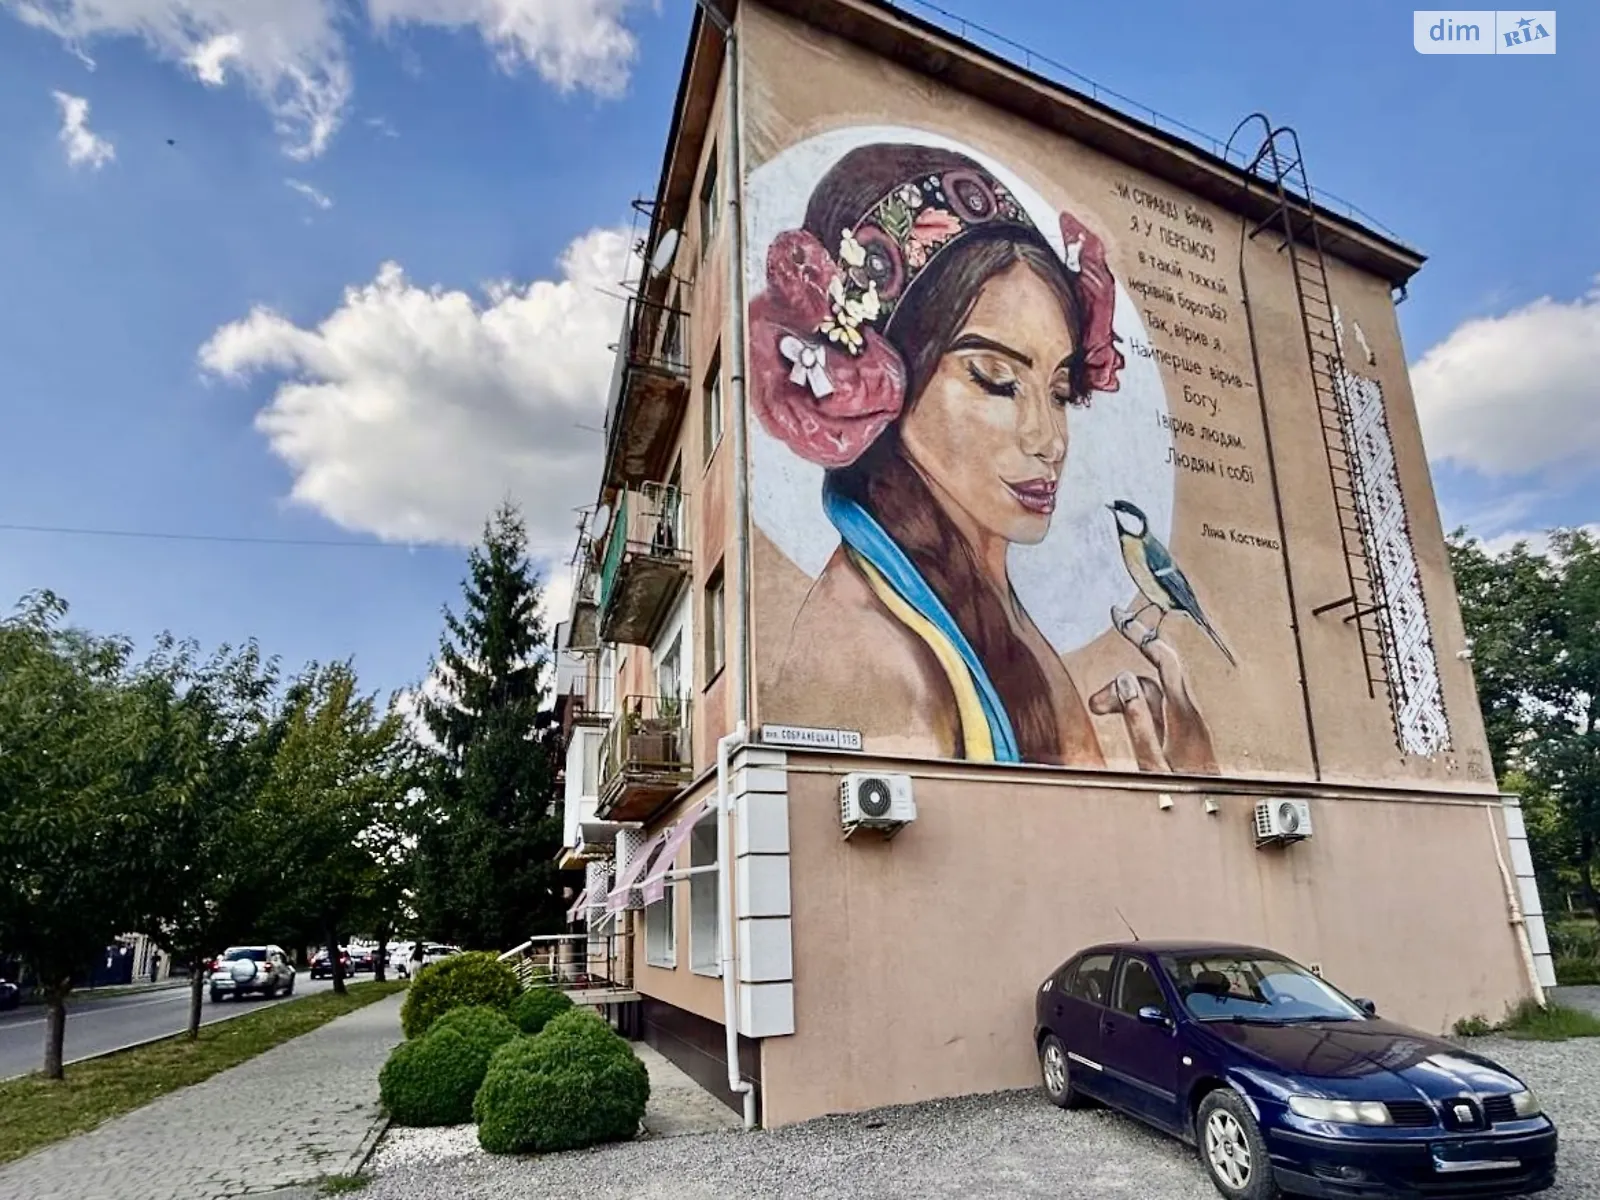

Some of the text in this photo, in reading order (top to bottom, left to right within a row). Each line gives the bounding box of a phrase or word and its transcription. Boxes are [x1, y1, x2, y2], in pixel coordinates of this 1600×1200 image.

[1130, 336, 1202, 375] Найперше
[1162, 411, 1195, 439] вірив
[1165, 446, 1216, 475] Людям
[1227, 464, 1255, 484] собі
